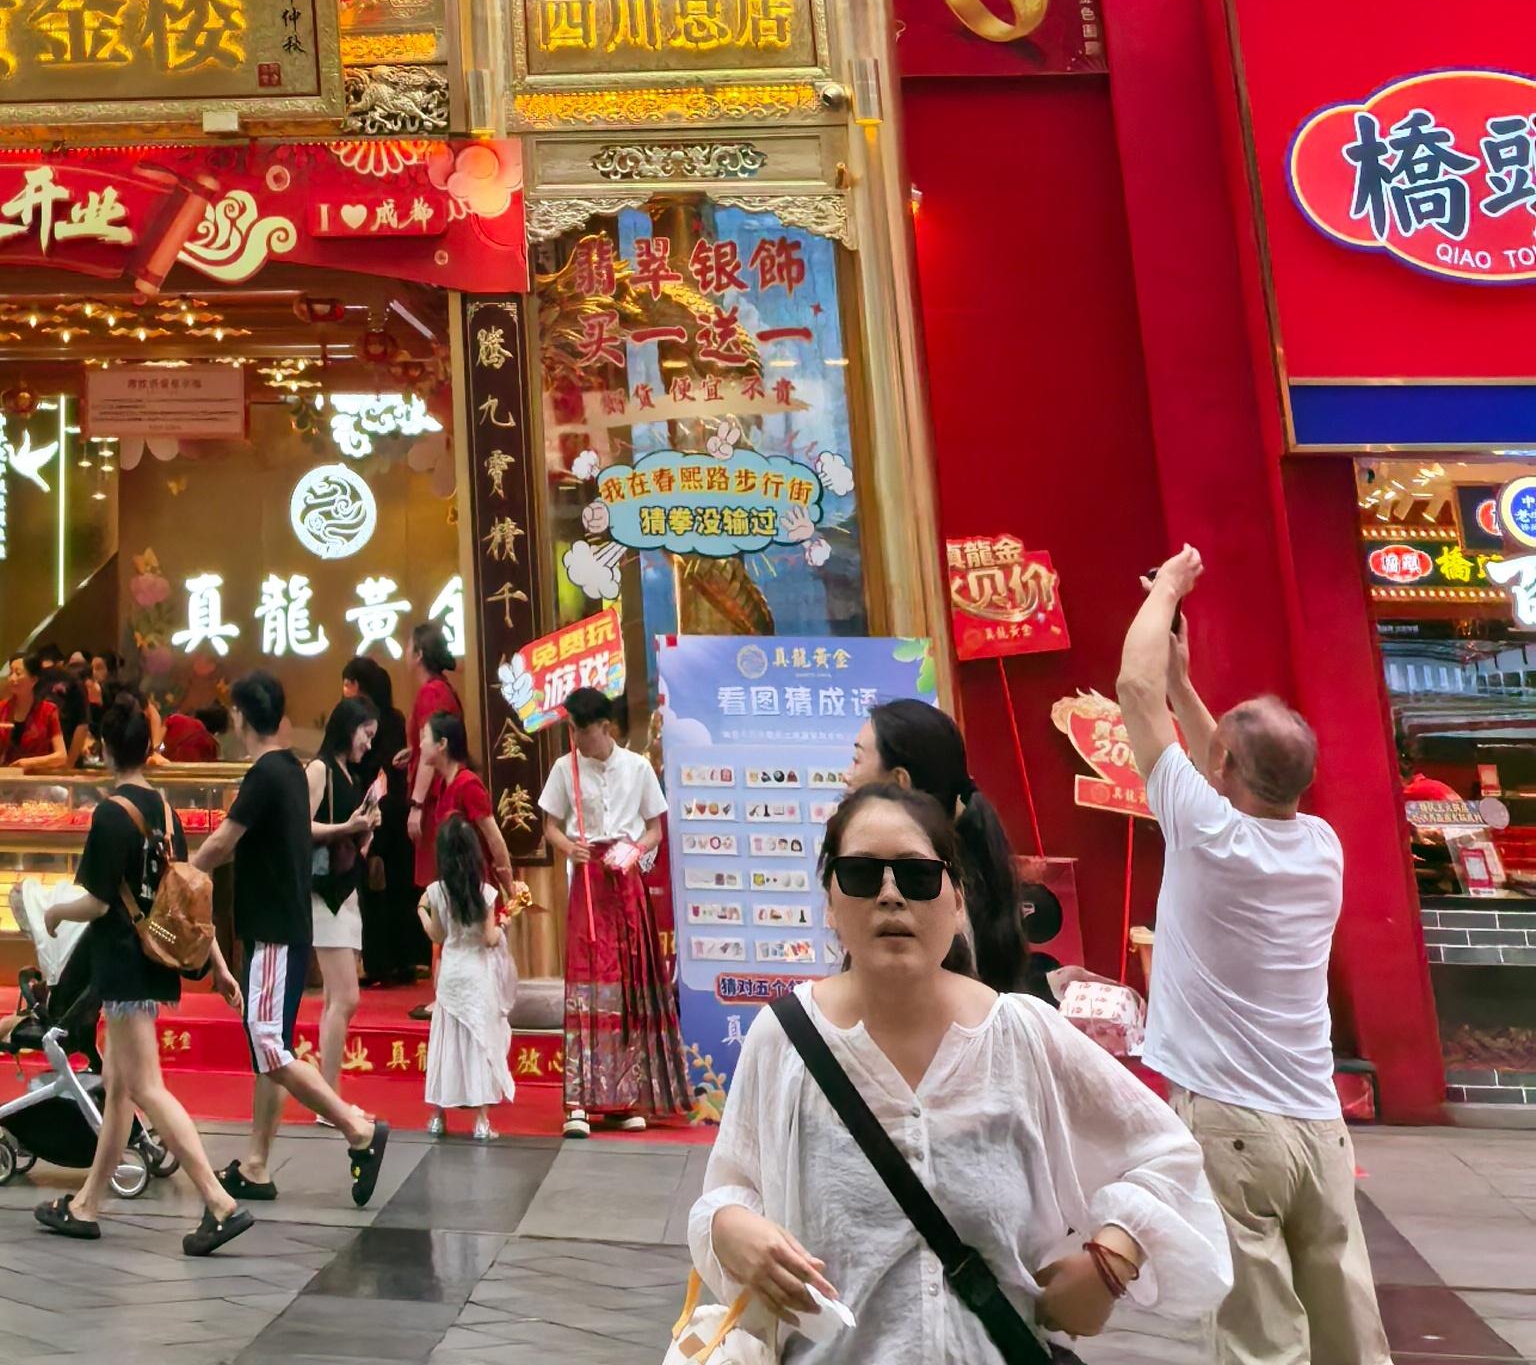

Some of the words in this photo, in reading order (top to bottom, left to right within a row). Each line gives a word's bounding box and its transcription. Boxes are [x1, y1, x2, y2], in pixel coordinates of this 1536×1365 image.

[1436, 243, 1492, 269] QIAO
[1504, 246, 1536, 269] TO
[576, 306, 815, 368] 买一送一
[598, 466, 814, 506] 我在春熙路步行街
[639, 506, 779, 537] 猜拳没输过
[718, 686, 879, 719] 看图猜成语
